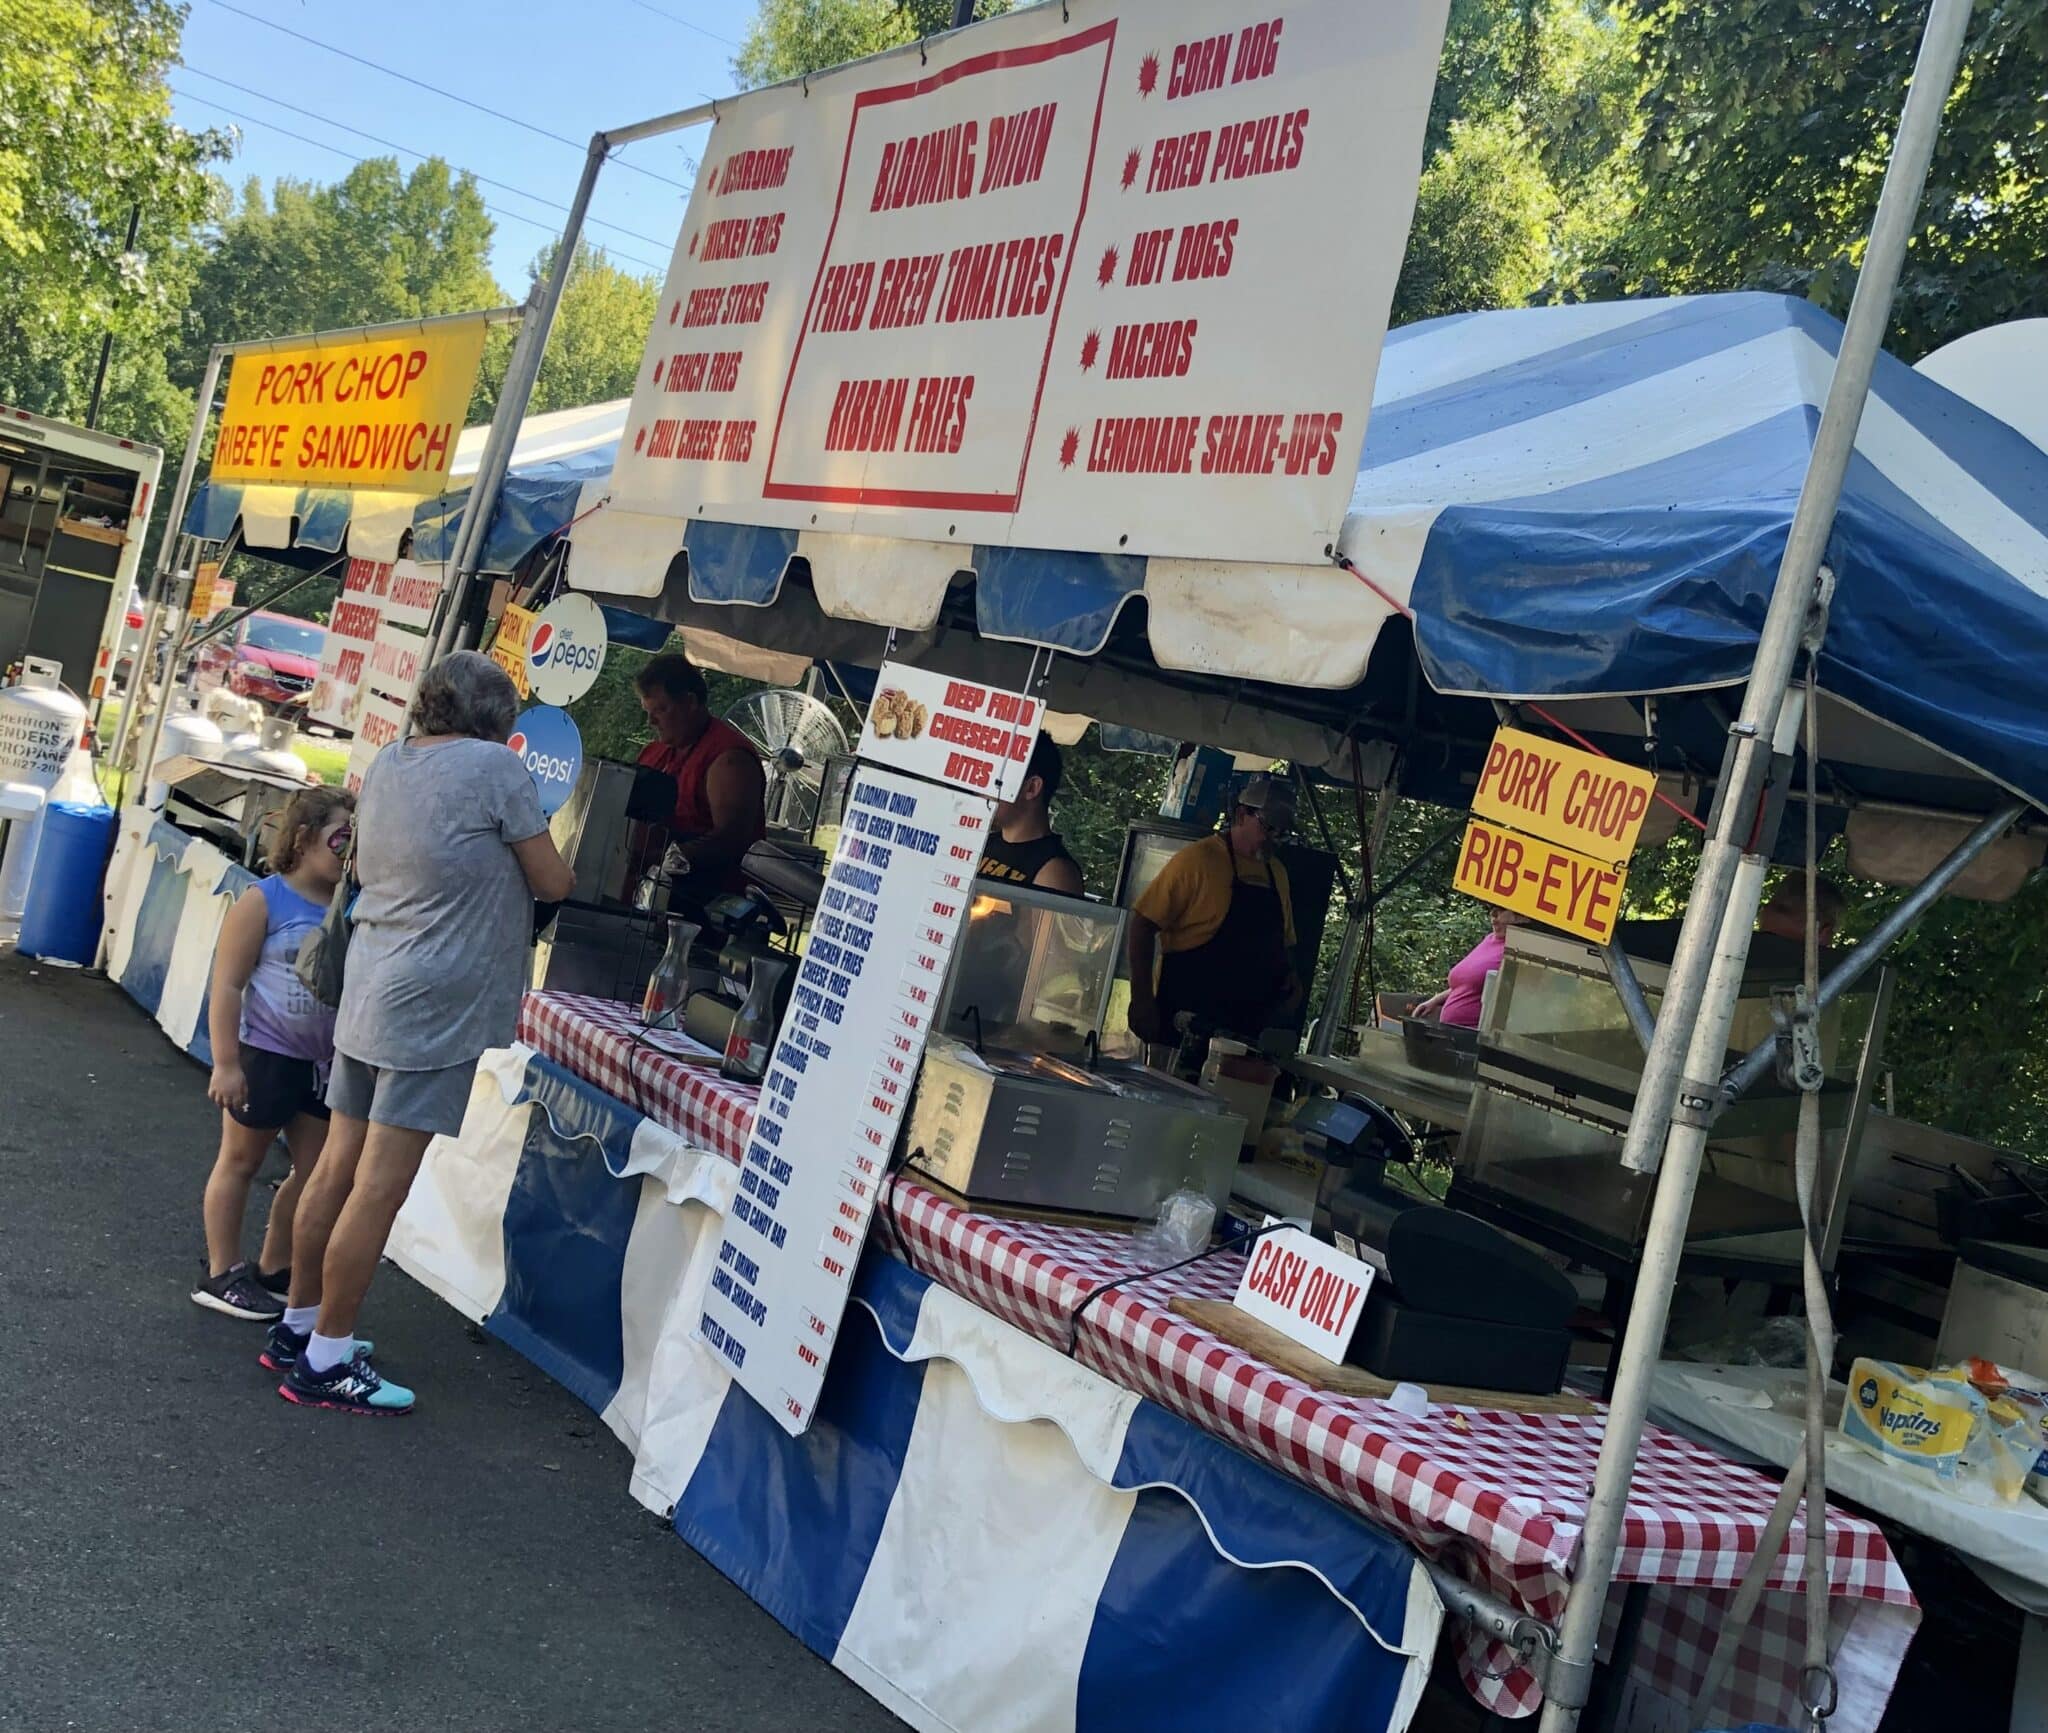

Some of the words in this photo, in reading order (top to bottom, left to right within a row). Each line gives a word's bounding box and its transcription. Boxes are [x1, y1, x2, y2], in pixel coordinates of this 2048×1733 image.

[1167, 33, 1233, 100] CORN
[1231, 18, 1283, 85] DOG
[870, 120, 977, 213] BLOOMING
[980, 102, 1057, 194] ONION
[1146, 130, 1212, 194] FRIED
[1210, 109, 1309, 183] PICKLES
[747, 212, 786, 256] FRIES
[1126, 228, 1174, 287] HOT
[1172, 219, 1239, 281] DOGS
[812, 261, 872, 333] FRIED
[868, 253, 945, 330] GREEN
[935, 233, 1064, 323] TOMATOES
[683, 287, 728, 328] CHEESE
[722, 281, 769, 324] STICKS
[1106, 319, 1197, 379] NACHOS
[255, 357, 336, 405] PORK
[334, 350, 427, 402] CHOP
[664, 353, 711, 392] FRENCH
[707, 351, 743, 392] FRIES
[825, 378, 911, 451] RIBBON
[903, 375, 974, 453] FRIES
[217, 424, 289, 467] RIBEYE
[298, 423, 452, 472] SANDWICH
[647, 419, 681, 457] CHILI
[677, 420, 722, 461] CHEESE
[718, 420, 756, 462] FRIES
[1087, 416, 1201, 472] LEMONADE
[1201, 413, 1342, 475] SHAKE-UPS
[551, 643, 602, 674] pepsi
[944, 681, 986, 713] DEEP
[944, 752, 994, 789] BITES
[888, 792, 918, 818] ONION
[1478, 742, 1561, 816] PORK
[1563, 769, 1647, 841] CHOP
[867, 815, 895, 842] GREEN
[893, 823, 940, 856] TOMATOES
[959, 815, 982, 829] OUT
[868, 844, 892, 869] FRIES
[950, 846, 973, 861] OUT
[823, 886, 846, 911] FRIED
[1461, 827, 1618, 933] RIB-EYE
[932, 901, 956, 918] OUT
[809, 936, 841, 969] CHICKEN
[840, 949, 864, 977] FRIES
[842, 923, 873, 951] STICKS
[801, 959, 831, 988] CHEESE
[829, 972, 851, 999] FRIES
[821, 997, 845, 1025] FRIES
[872, 1095, 895, 1116] OUT
[739, 1167, 759, 1195] FRIED
[768, 1155, 793, 1186] CAKES
[731, 1194, 751, 1222] FRIED
[749, 1206, 774, 1239] CANDY
[771, 1225, 788, 1250] BAR
[839, 1201, 861, 1223] OUT
[832, 1225, 854, 1247] OUT
[712, 1266, 734, 1297] LEMON
[719, 1240, 737, 1266] SOFT
[734, 1252, 760, 1287] DRINKS
[823, 1256, 845, 1278] OUT
[1248, 1240, 1308, 1310] CASH
[1300, 1266, 1361, 1337] ONLY
[722, 1332, 746, 1369] WATER
[798, 1344, 819, 1368] OUT
